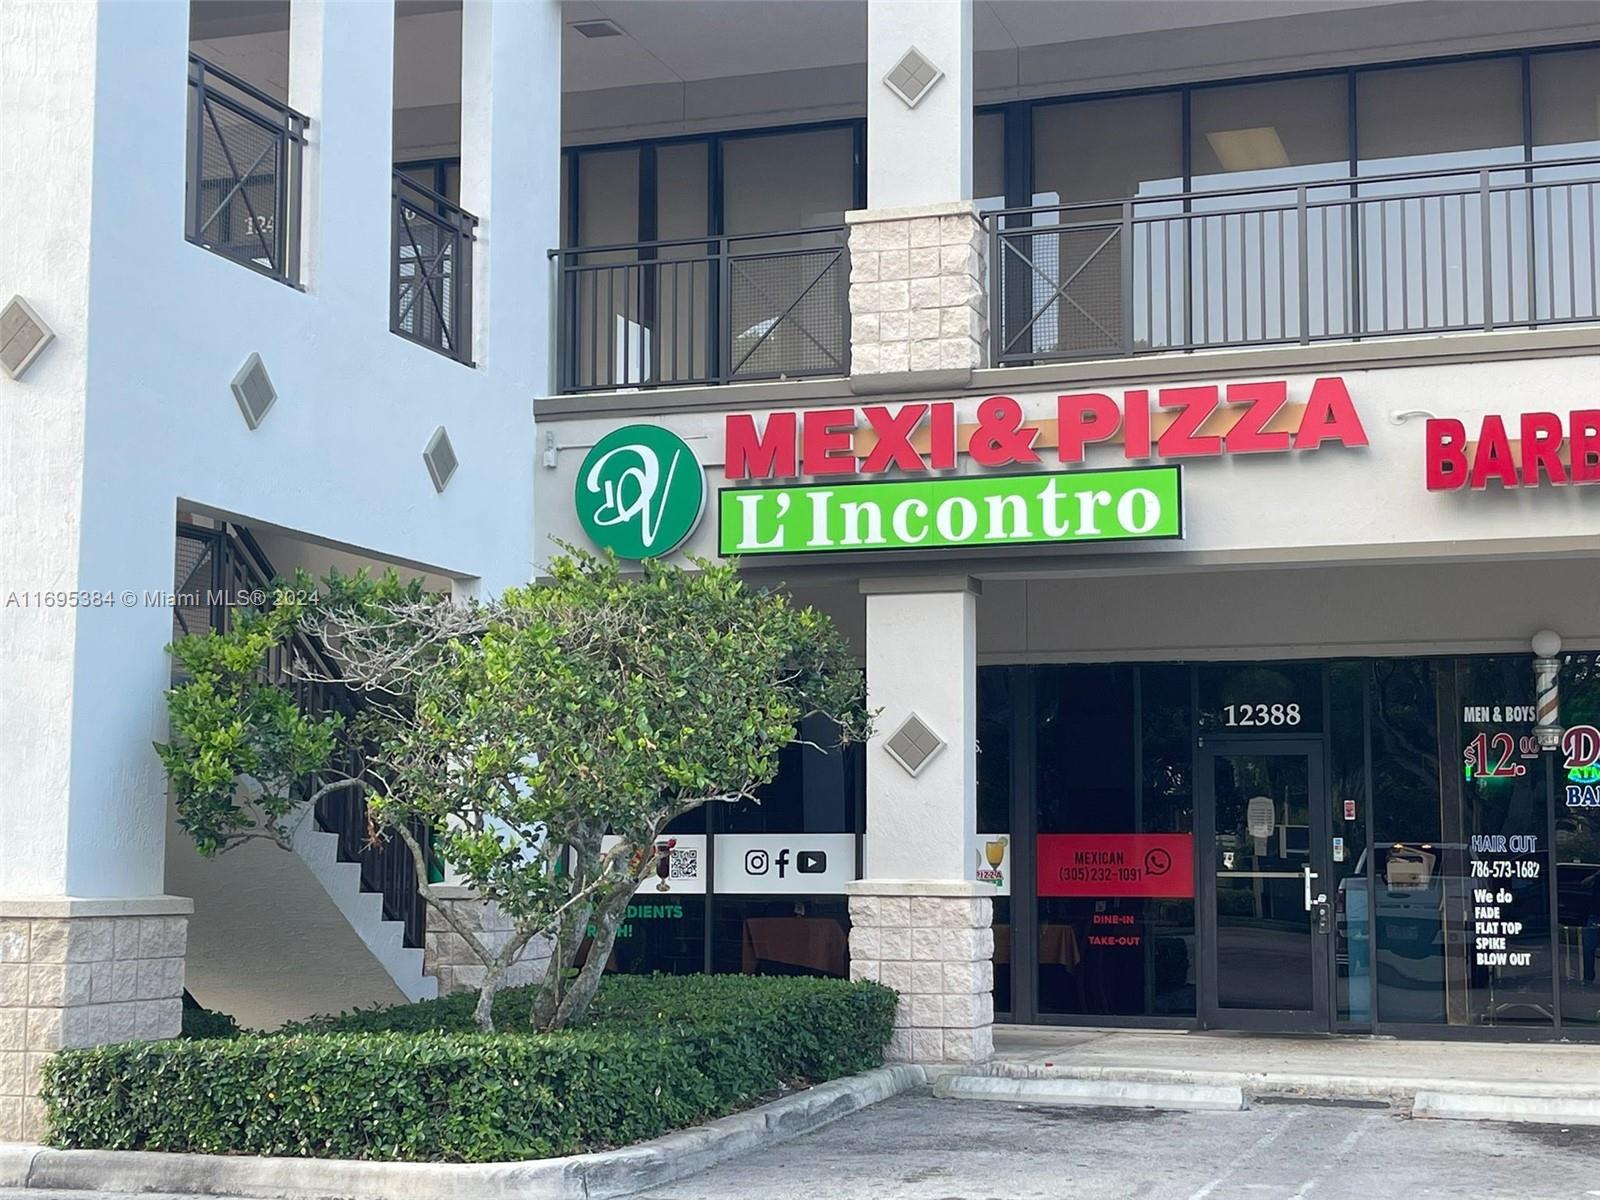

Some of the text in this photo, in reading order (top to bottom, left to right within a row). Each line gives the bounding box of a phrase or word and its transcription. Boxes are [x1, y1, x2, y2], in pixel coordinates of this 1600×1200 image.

[724, 376, 1370, 480] MEXI & PIZZA
[1223, 703, 1301, 726] 12388
[1464, 706, 1536, 723] MEN & BOYS
[1471, 835, 1537, 853] HAIR CUT
[1074, 851, 1125, 865] MEXICAN
[1470, 861, 1540, 878] 786-573-1682
[1474, 888, 1512, 903] We do
[1093, 914, 1135, 925] DINE-IN
[1475, 907, 1500, 919] FADE
[1475, 922, 1522, 935] FLAT TOP
[1088, 935, 1141, 946] TAKE-OUT
[1475, 937, 1506, 950] SPIKE
[1476, 953, 1531, 966] BLOW OUT
